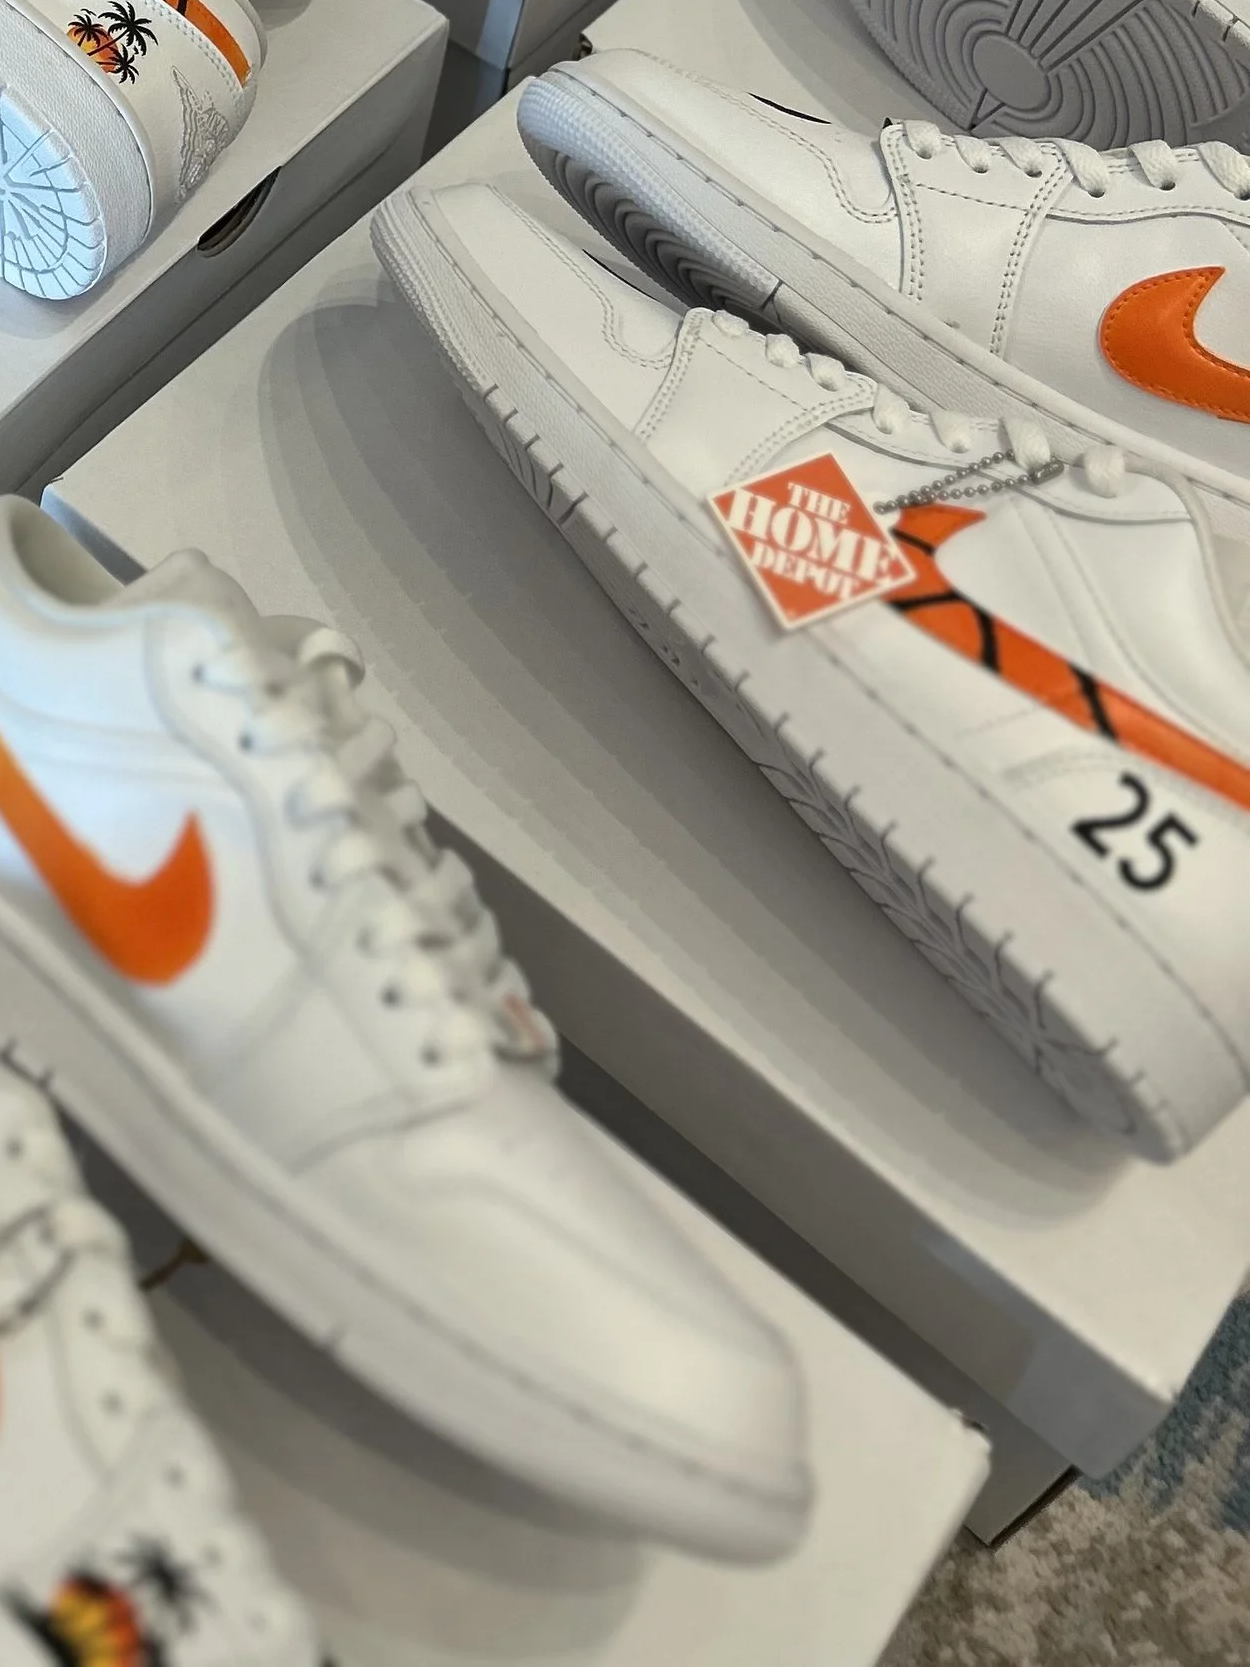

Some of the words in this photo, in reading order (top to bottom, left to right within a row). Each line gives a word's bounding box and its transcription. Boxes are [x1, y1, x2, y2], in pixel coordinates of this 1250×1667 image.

[729, 488, 900, 586] HOME
[787, 481, 850, 525] THE
[751, 540, 860, 601] DEPOT
[1071, 770, 1199, 894] 25
